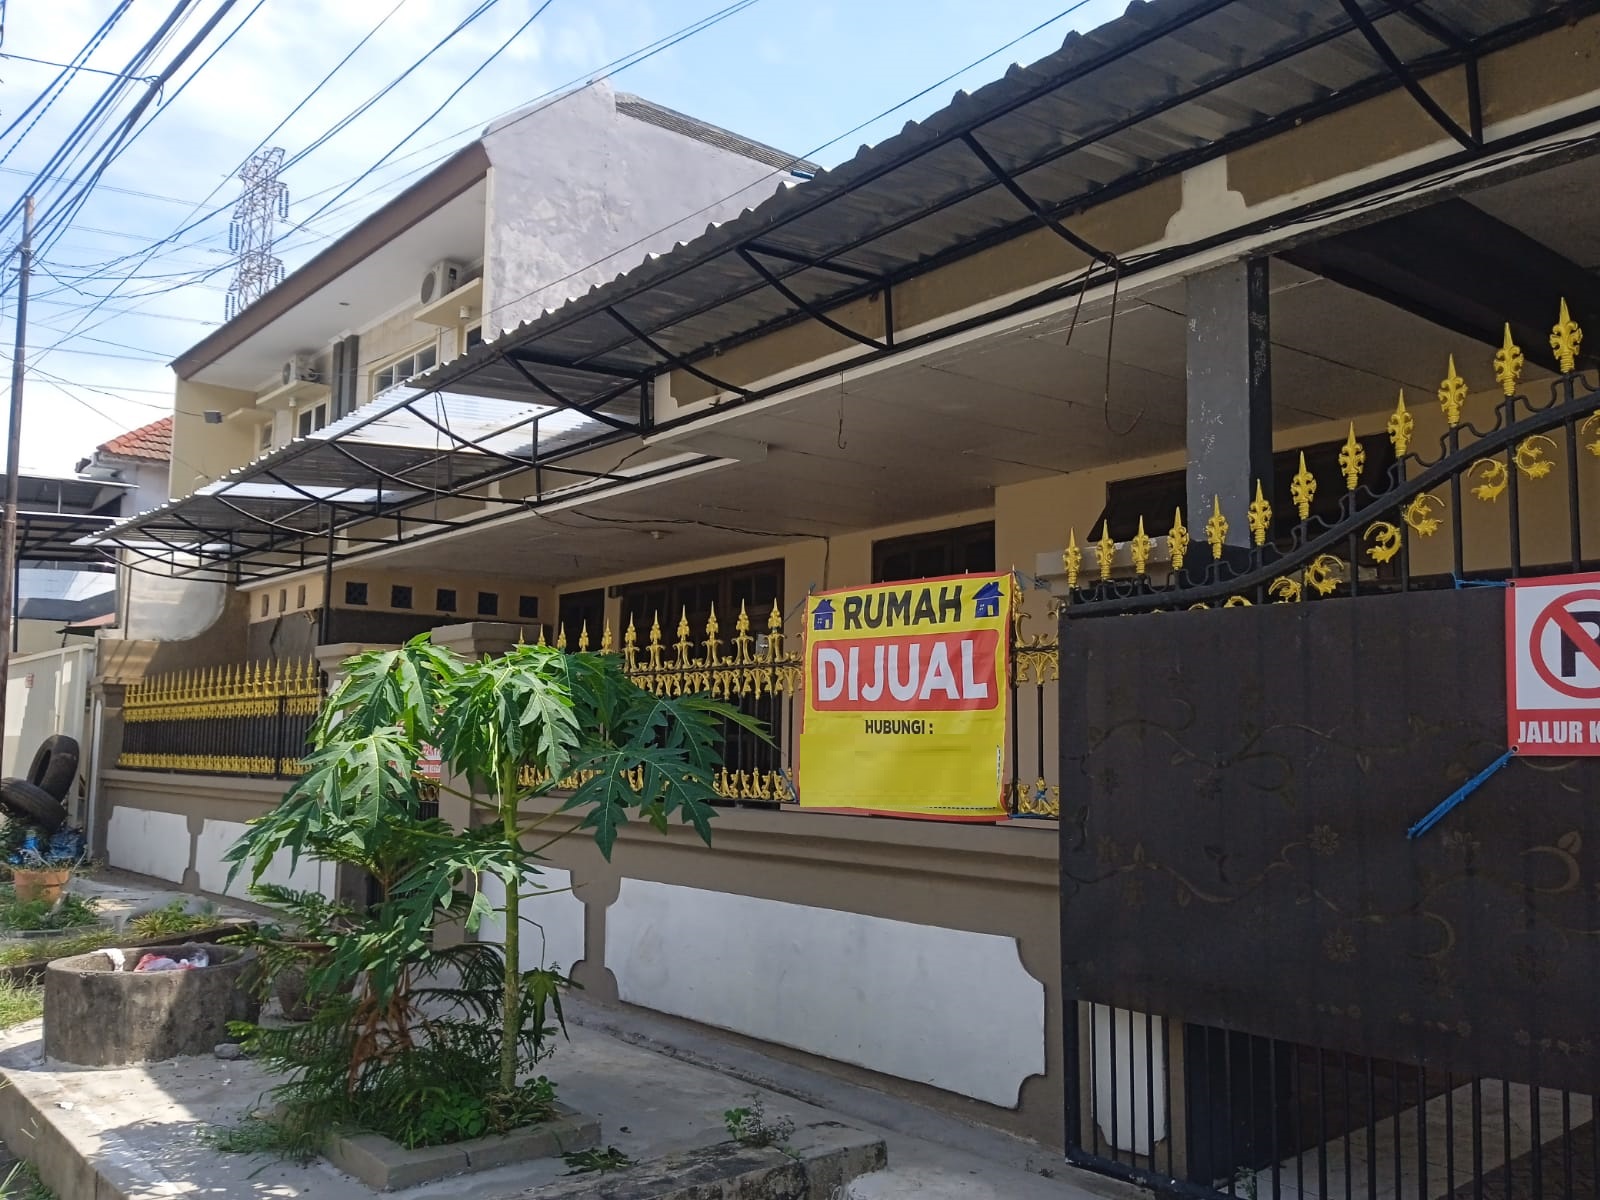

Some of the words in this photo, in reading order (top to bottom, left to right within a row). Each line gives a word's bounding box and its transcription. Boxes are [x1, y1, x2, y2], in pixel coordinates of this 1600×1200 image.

[844, 585, 962, 630] RUMAH
[818, 640, 988, 701] DIJUAL
[1518, 721, 1583, 743] JALUR
